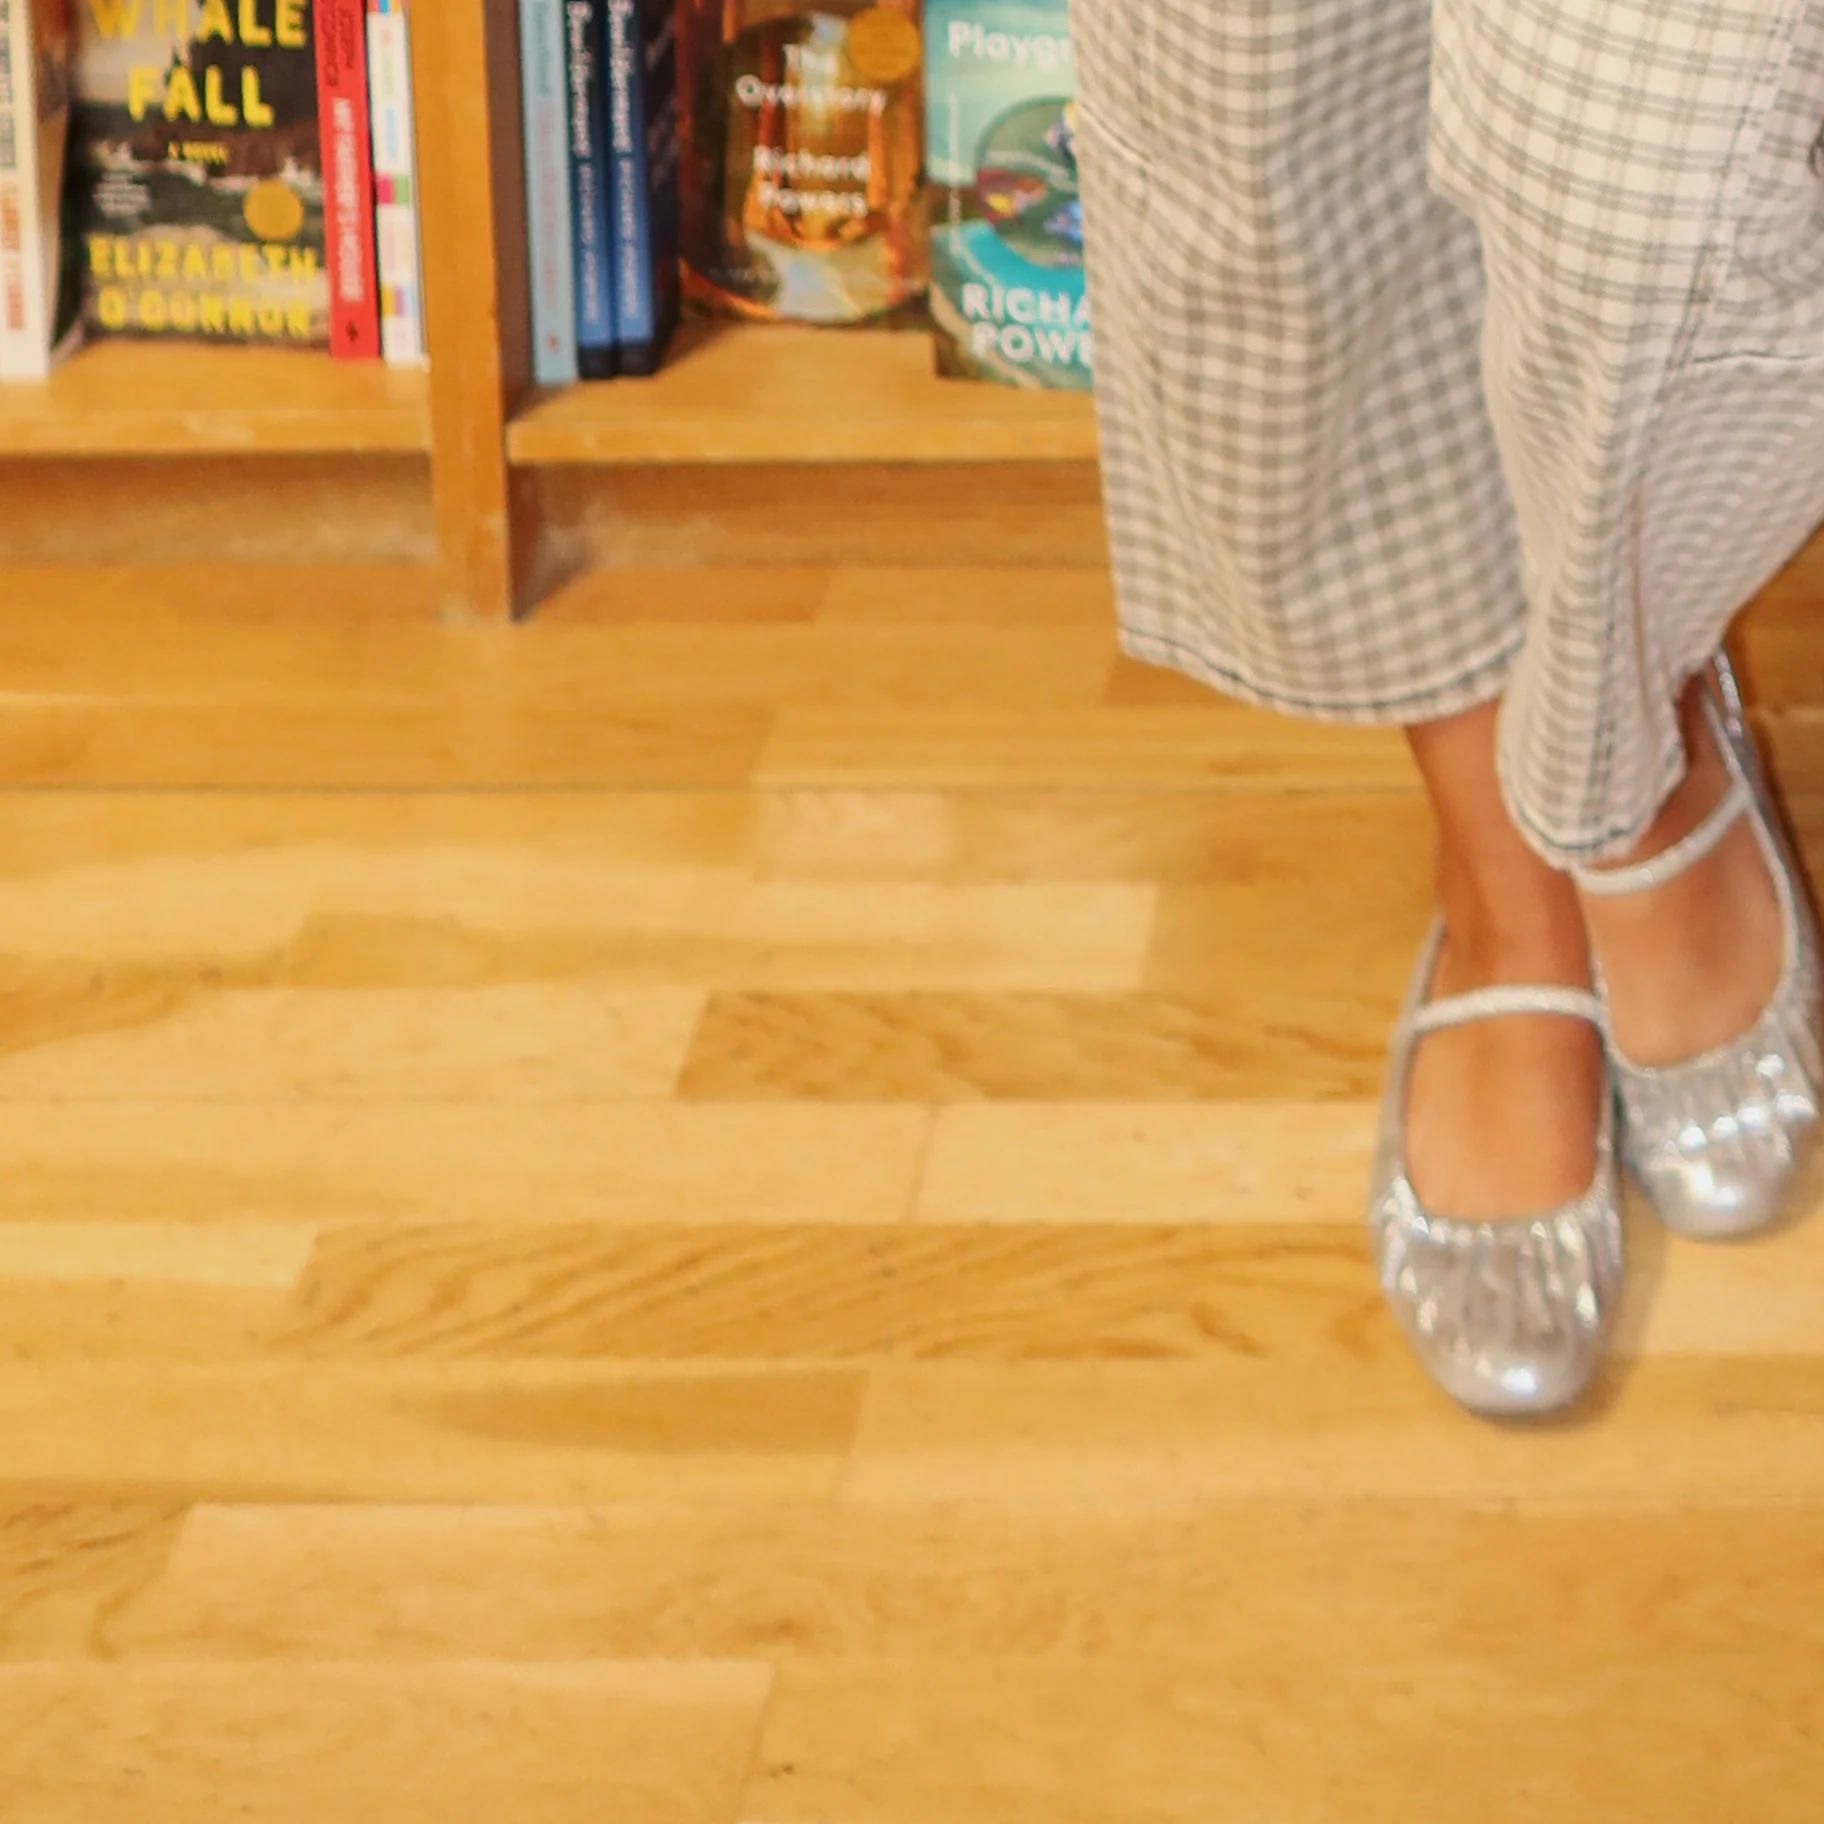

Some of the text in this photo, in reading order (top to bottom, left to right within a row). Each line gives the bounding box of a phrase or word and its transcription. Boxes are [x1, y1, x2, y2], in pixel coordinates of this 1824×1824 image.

[782, 41, 839, 76] The
[127, 66, 274, 129] FALL
[735, 74, 887, 114] Overstory
[753, 145, 869, 181] Richard
[758, 183, 869, 217] Powers
[88, 236, 321, 285] ELIZABETH
[97, 288, 312, 337] O'CONNOR
